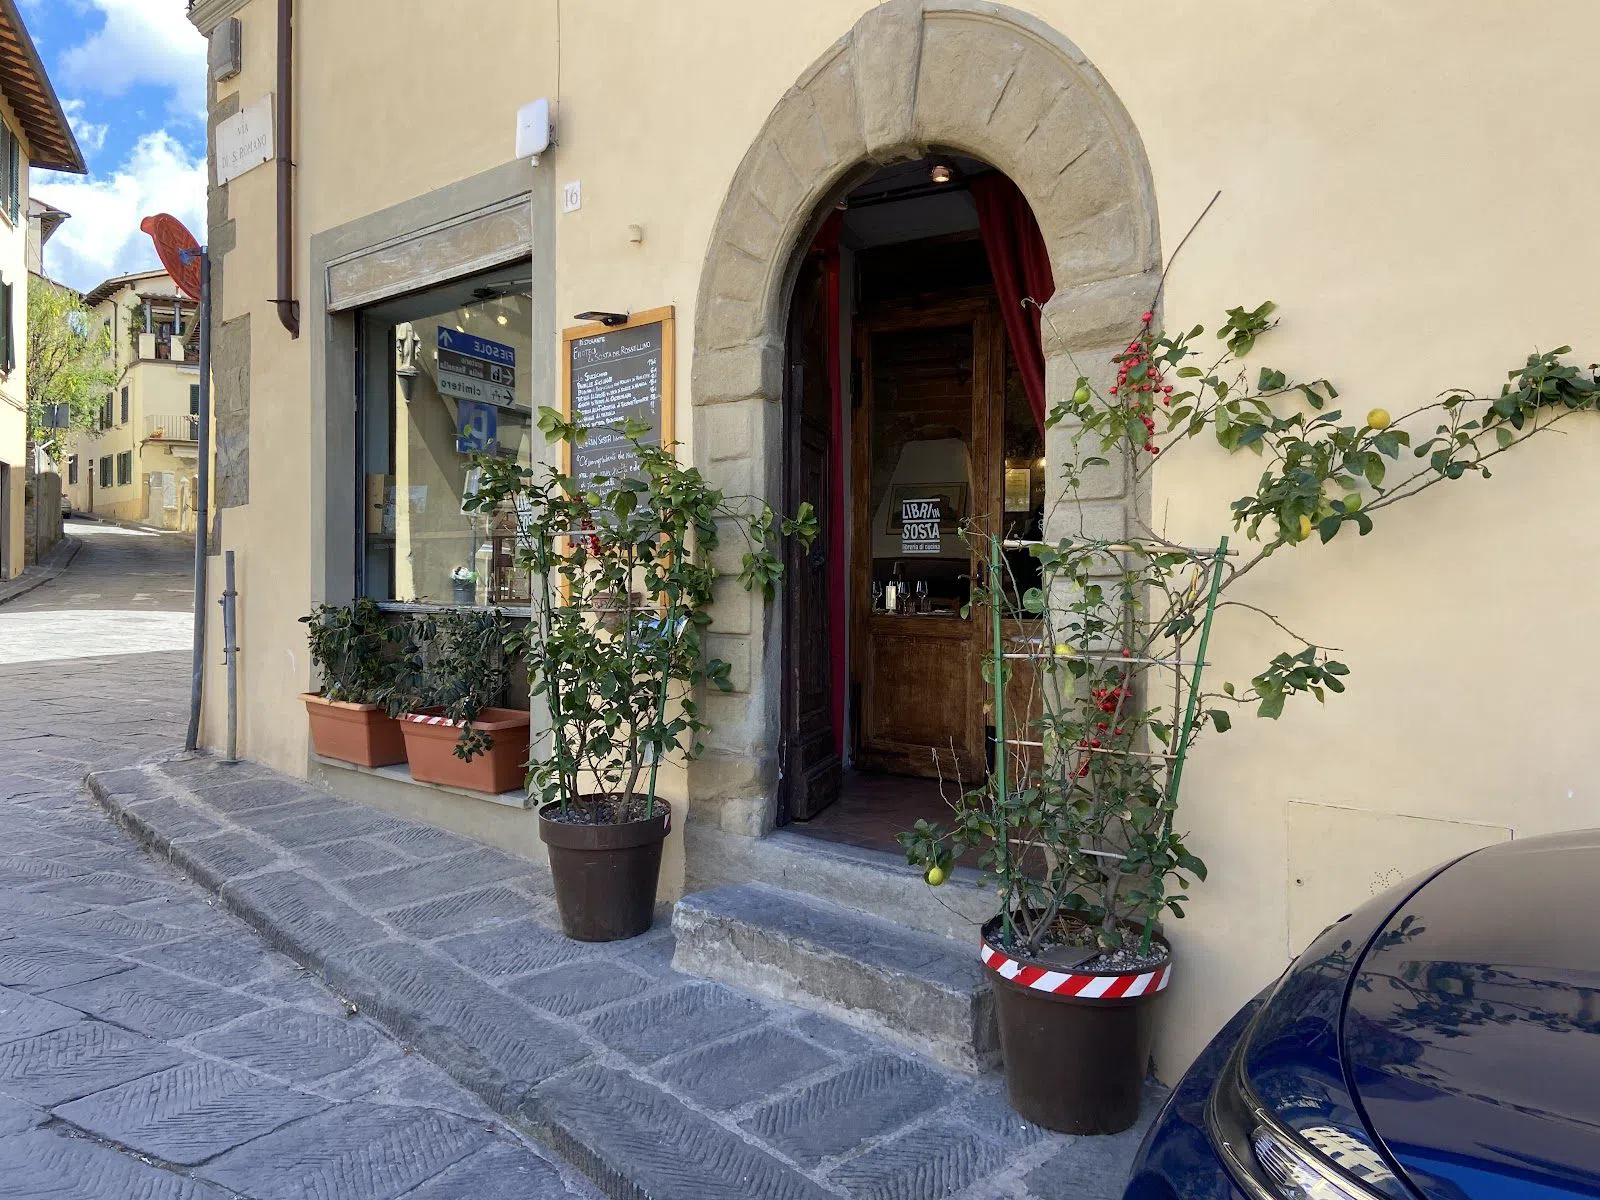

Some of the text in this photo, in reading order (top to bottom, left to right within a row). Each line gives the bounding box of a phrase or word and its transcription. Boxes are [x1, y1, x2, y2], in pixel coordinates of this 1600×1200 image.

[237, 123, 249, 136] VIA
[222, 155, 230, 169] DI
[240, 134, 267, 159] ROMANO
[565, 187, 578, 208] 16
[903, 503, 940, 519] LIBRI IN
[902, 523, 940, 539] SOSTA
